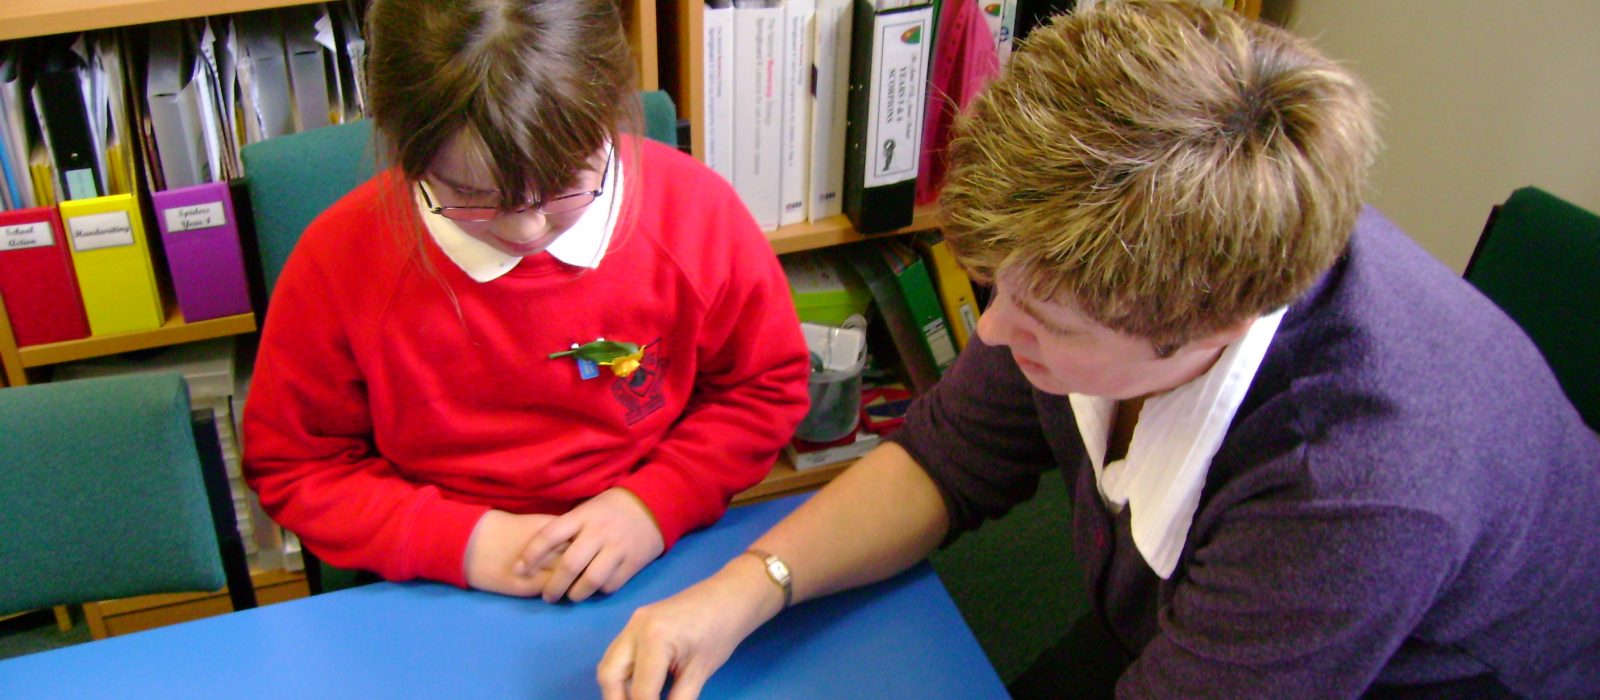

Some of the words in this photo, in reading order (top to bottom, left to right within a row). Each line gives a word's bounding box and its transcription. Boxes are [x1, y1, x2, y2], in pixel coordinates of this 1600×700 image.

[768, 17, 776, 29] The
[756, 17, 764, 59] Springboard
[767, 32, 776, 57] National
[765, 59, 775, 97] Numeracy
[899, 66, 908, 98] YEARS
[887, 69, 896, 123] SCORPIONS
[764, 100, 774, 125] Strategy
[896, 107, 906, 115] &
[178, 207, 210, 218] Spiders
[5, 226, 34, 236] School
[181, 219, 203, 230] Year
[75, 225, 131, 238] Handwriting
[8, 239, 37, 248] Action
